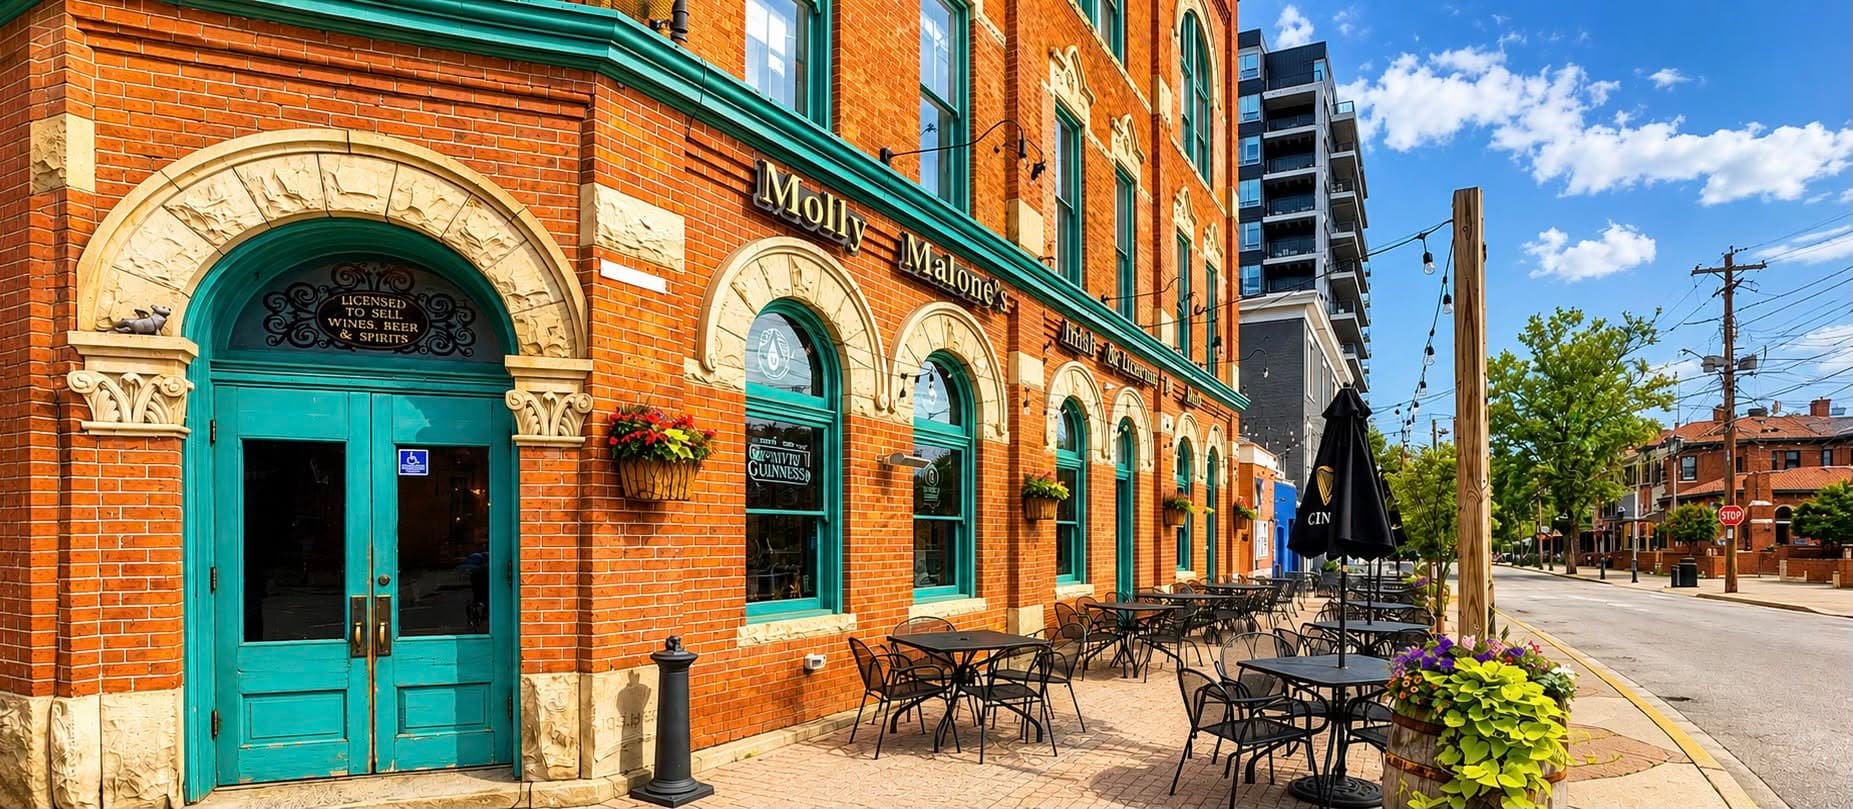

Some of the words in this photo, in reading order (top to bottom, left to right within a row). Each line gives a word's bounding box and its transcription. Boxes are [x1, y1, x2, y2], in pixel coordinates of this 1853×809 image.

[759, 158, 867, 252] Molly
[903, 232, 1009, 312] Malone's
[341, 295, 407, 309] LICENSED
[346, 307, 365, 317] TO
[371, 308, 403, 320] SELL
[383, 321, 418, 333] BEER
[339, 328, 352, 340] &
[360, 332, 409, 344] SPIRITS
[1721, 511, 1742, 520] STOP
